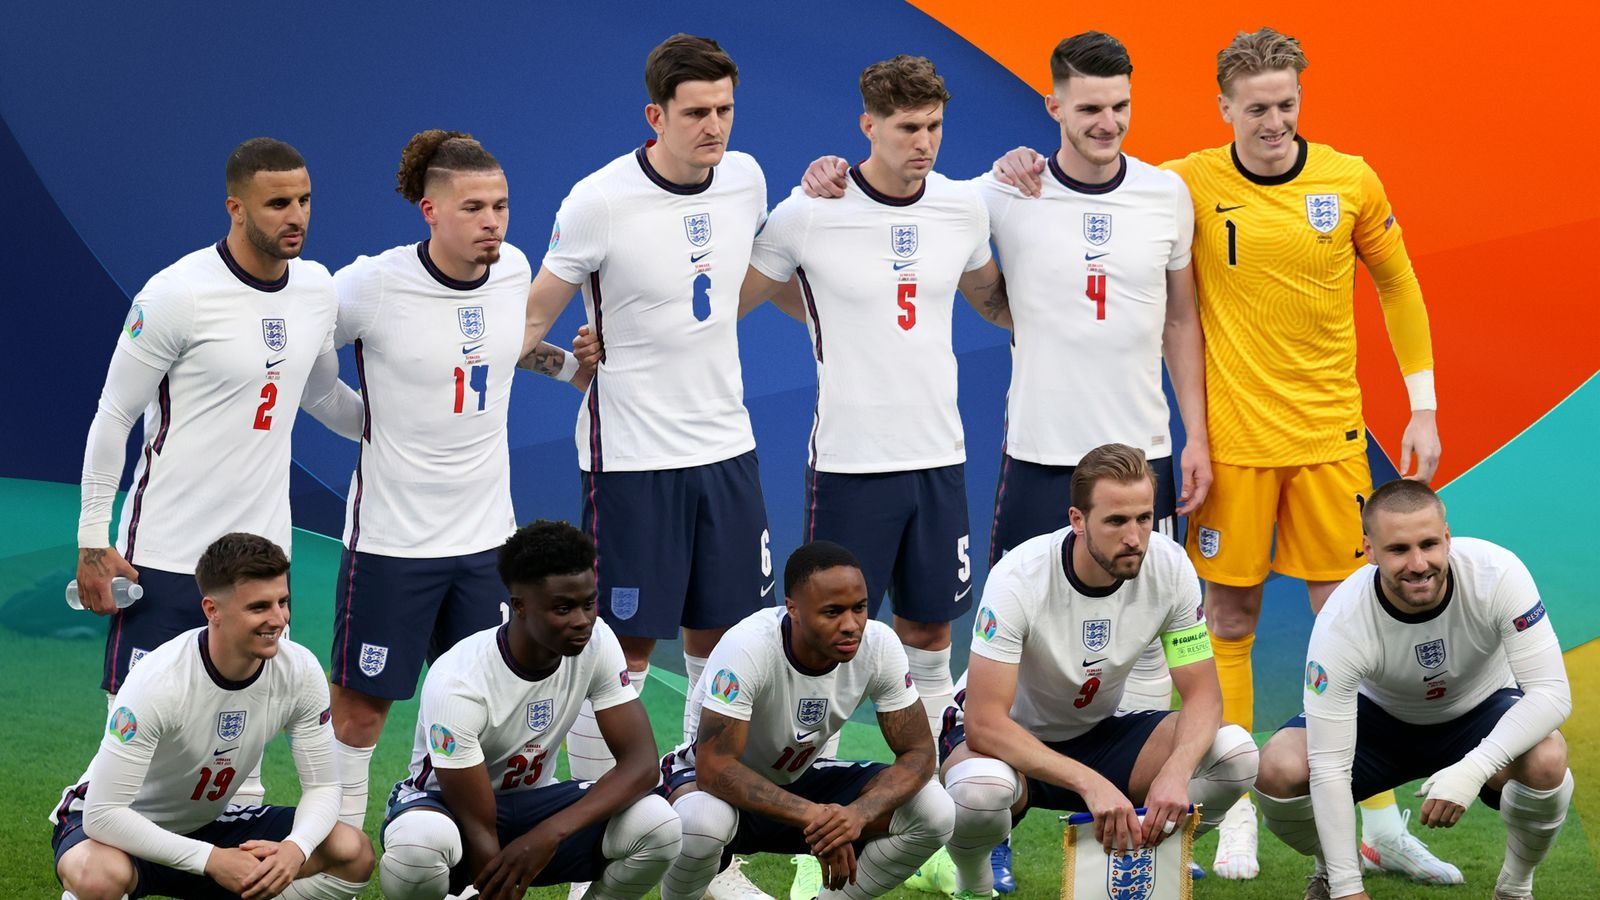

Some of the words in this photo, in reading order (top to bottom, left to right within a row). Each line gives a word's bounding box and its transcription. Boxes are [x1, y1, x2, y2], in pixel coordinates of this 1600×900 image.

[1225, 219, 1237, 266] 1
[692, 274, 712, 321] 6
[896, 282, 918, 332] 5
[1084, 273, 1107, 321] 4
[252, 382, 279, 431] 2
[760, 528, 773, 578] 6
[957, 534, 972, 583] 5
[1073, 677, 1101, 709] 9
[500, 749, 548, 790] 25
[771, 746, 816, 773] 10
[190, 766, 236, 801] 19
